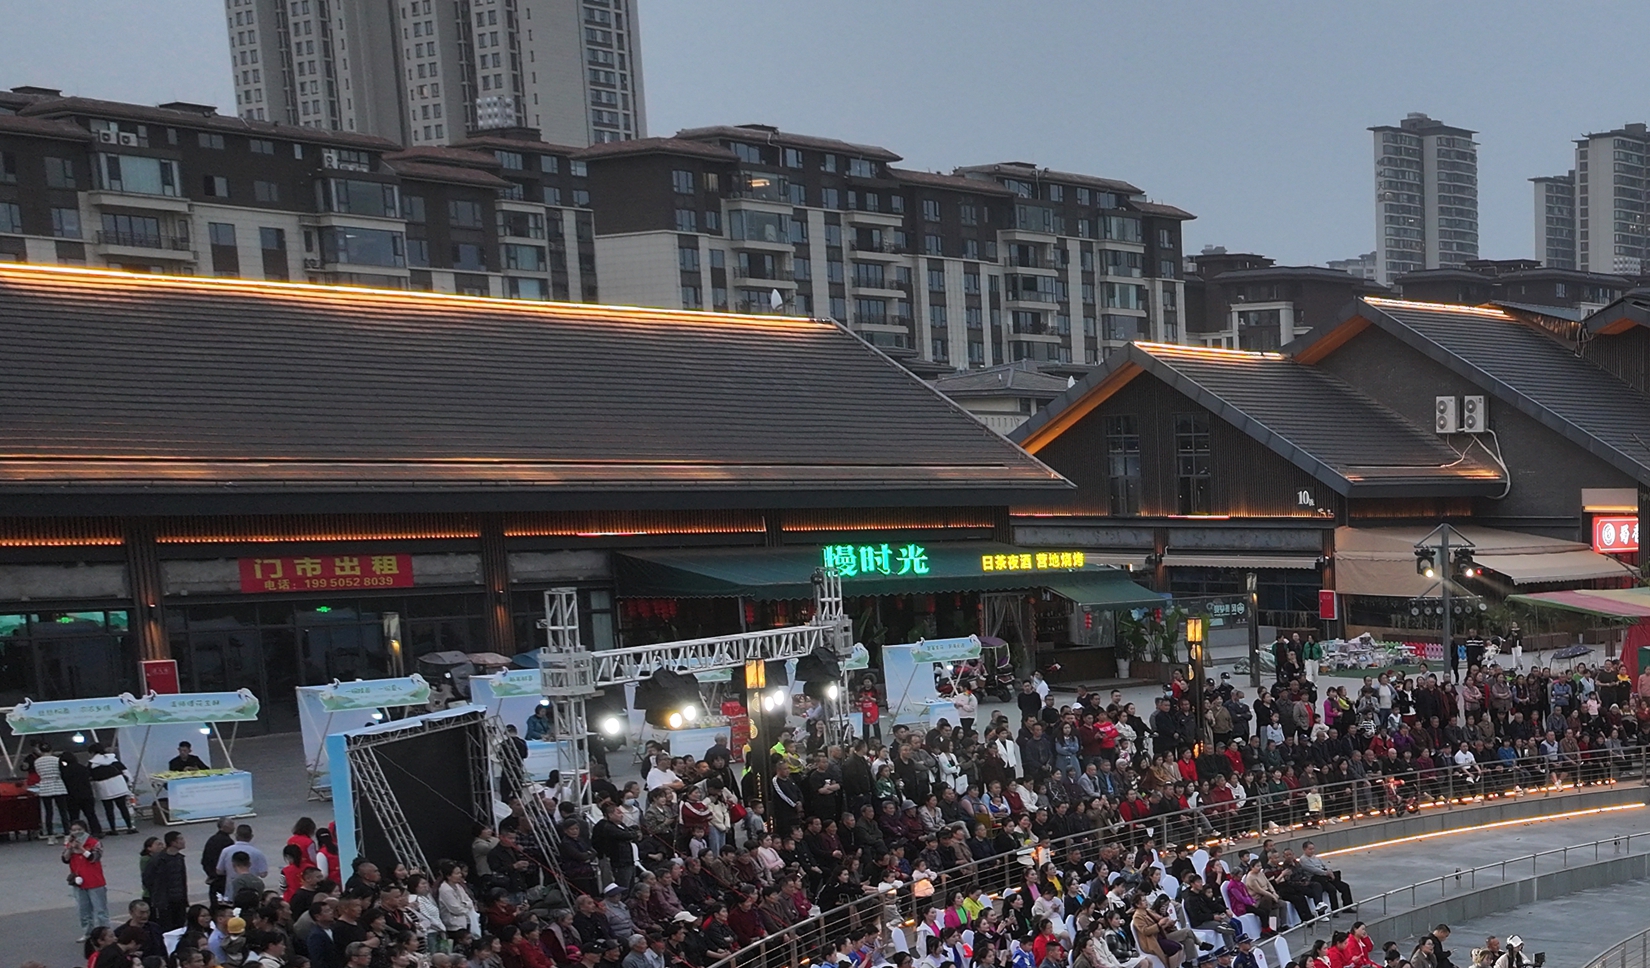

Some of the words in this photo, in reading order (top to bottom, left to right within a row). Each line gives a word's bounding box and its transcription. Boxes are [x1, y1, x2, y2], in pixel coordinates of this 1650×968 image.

[254, 555, 399, 579] 门市出租
[822, 543, 930, 577] 慢时光
[981, 553, 1032, 572] 日茶夜酒
[1035, 551, 1085, 569] 营地烧烤
[304, 579, 327, 589] 199
[330, 577, 360, 588] 5052
[364, 576, 394, 587] 8039
